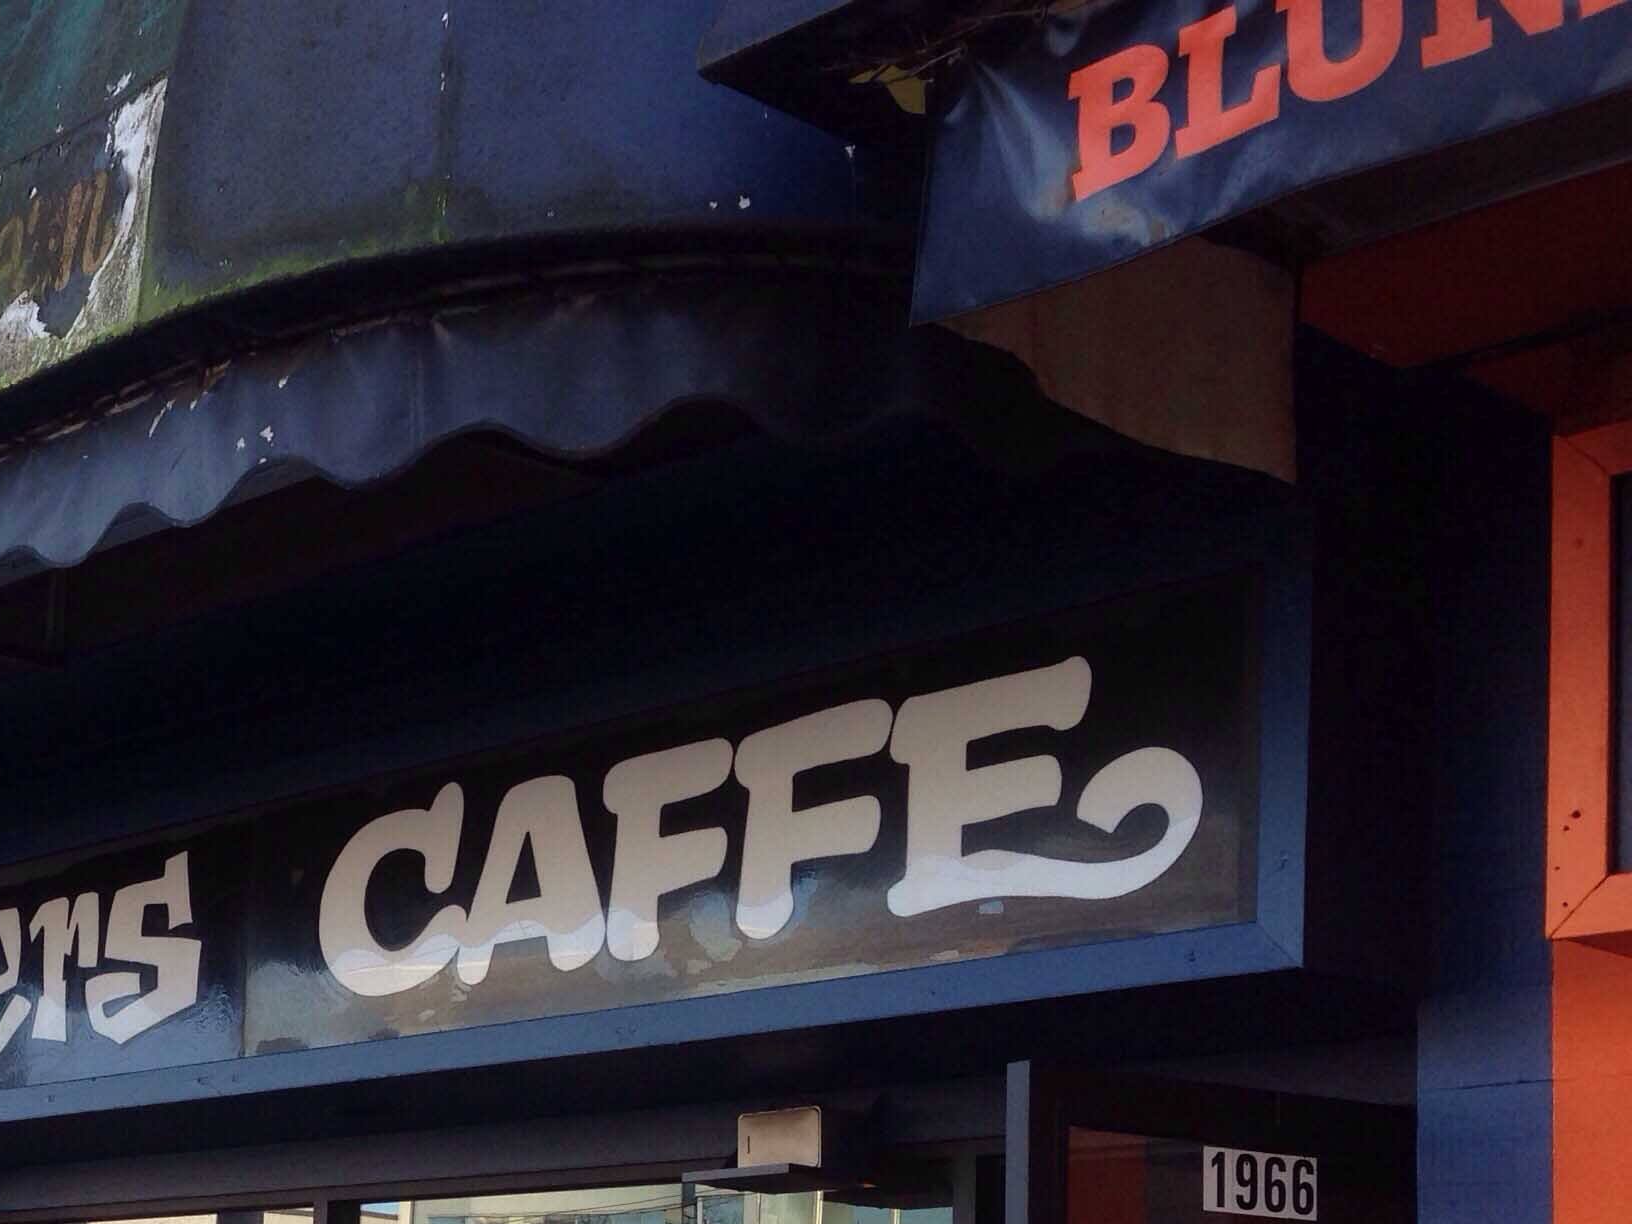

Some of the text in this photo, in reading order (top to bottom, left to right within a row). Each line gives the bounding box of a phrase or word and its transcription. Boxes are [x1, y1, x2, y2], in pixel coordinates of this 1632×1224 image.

[1067, 0, 1632, 201] BLU
[318, 655, 1205, 1000] CAFFE
[1210, 1151, 1315, 1216] 1966
